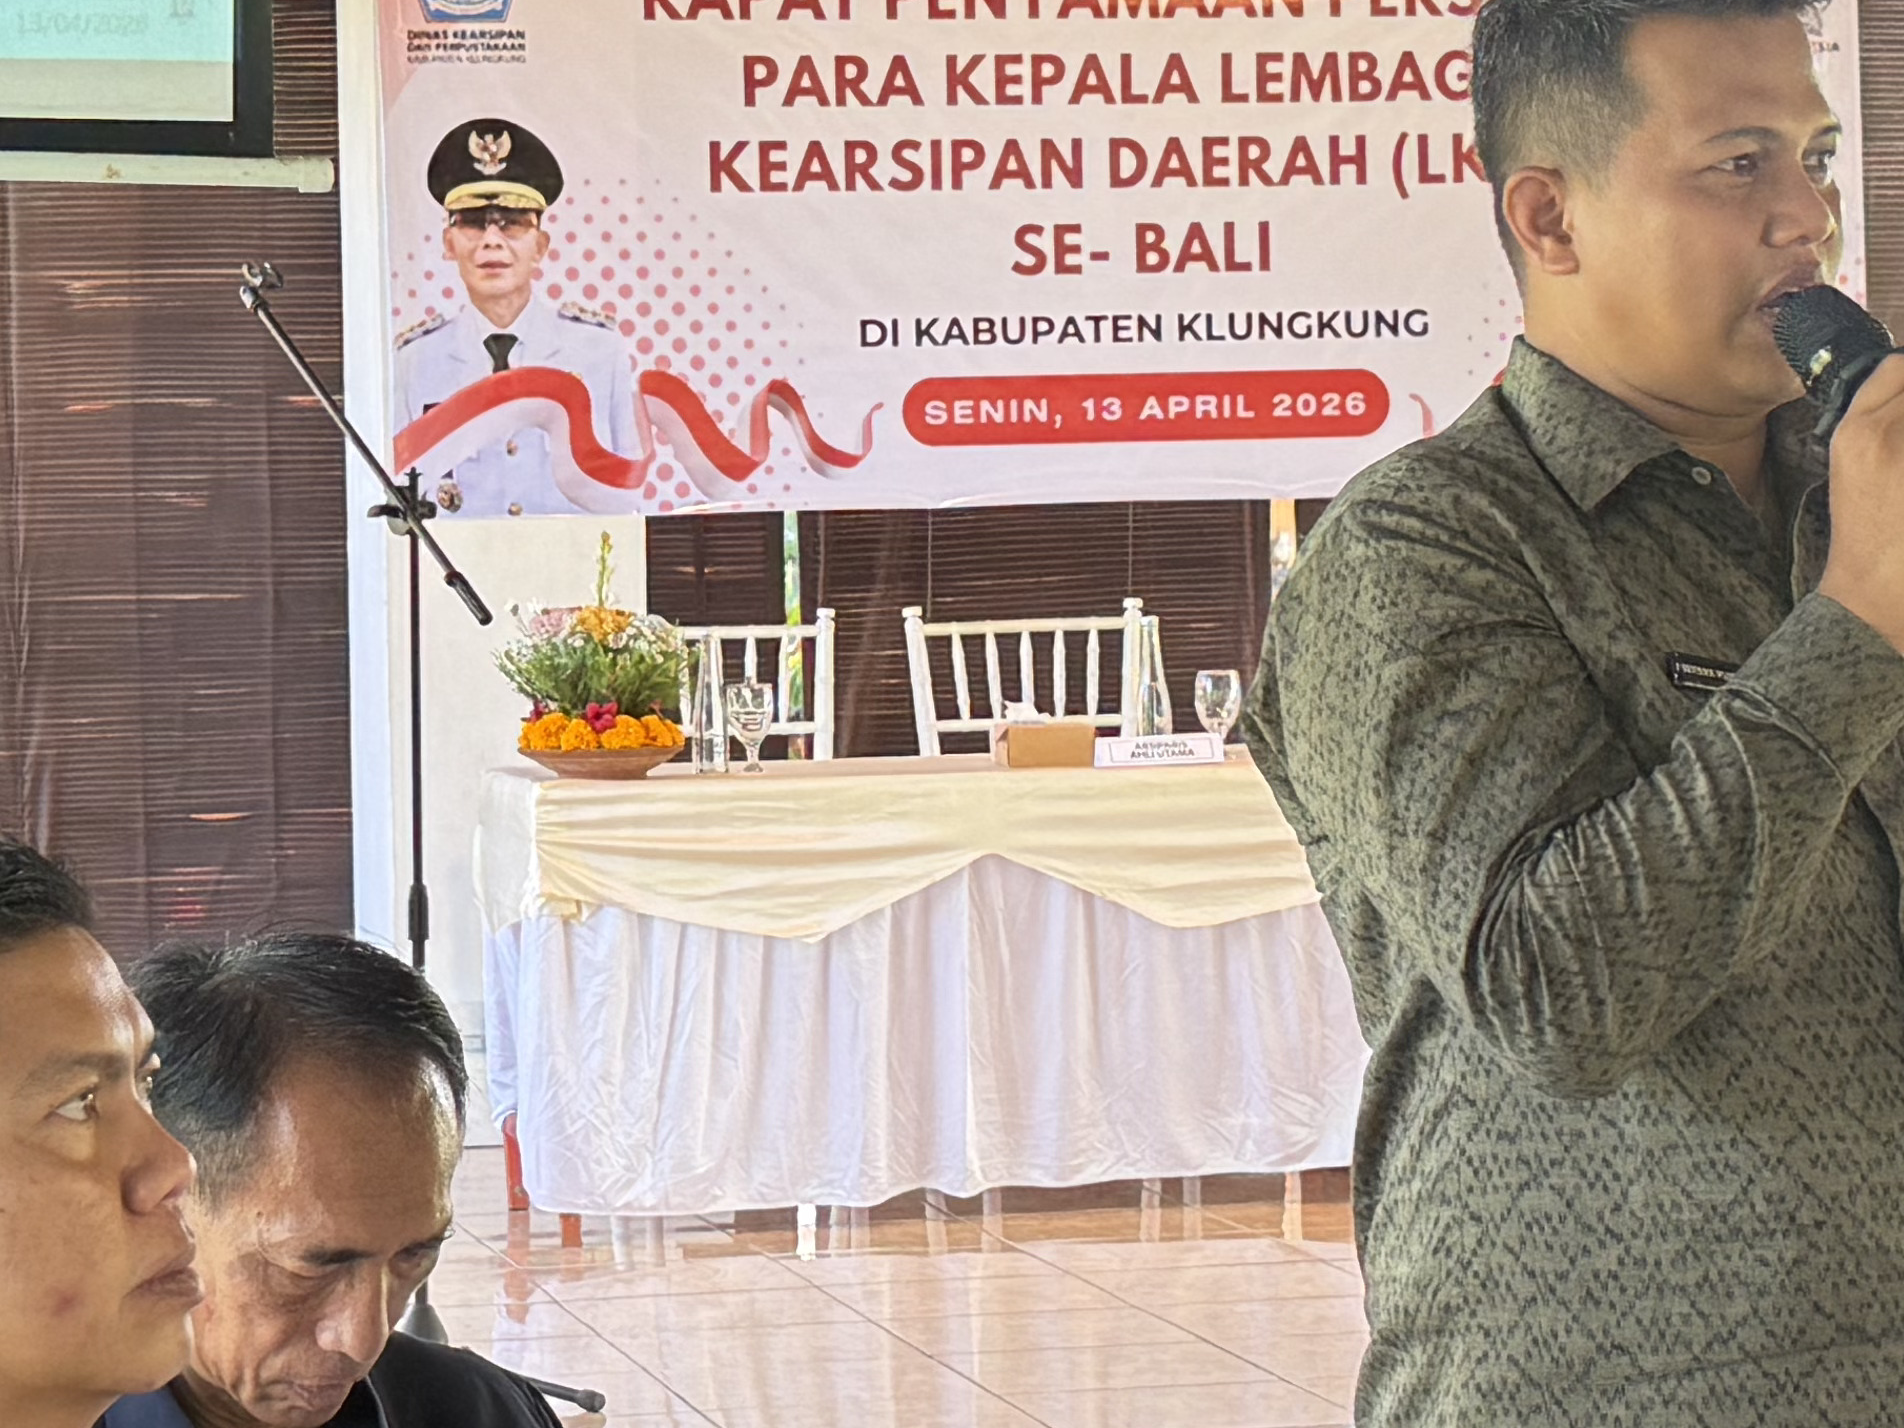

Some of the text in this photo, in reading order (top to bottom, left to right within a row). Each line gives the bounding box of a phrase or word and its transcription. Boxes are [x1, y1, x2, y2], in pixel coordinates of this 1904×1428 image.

[744, 50, 1474, 107] PARA KEPALA LEMBAG
[710, 132, 1487, 199] KEARSIPAN DAERAH (LK
[1011, 220, 1271, 276] SE- BALI
[859, 308, 1429, 347] DI KABUPATEN KLUNGKUNG
[923, 391, 1367, 429] SENIN, 13 APRIL 2026
